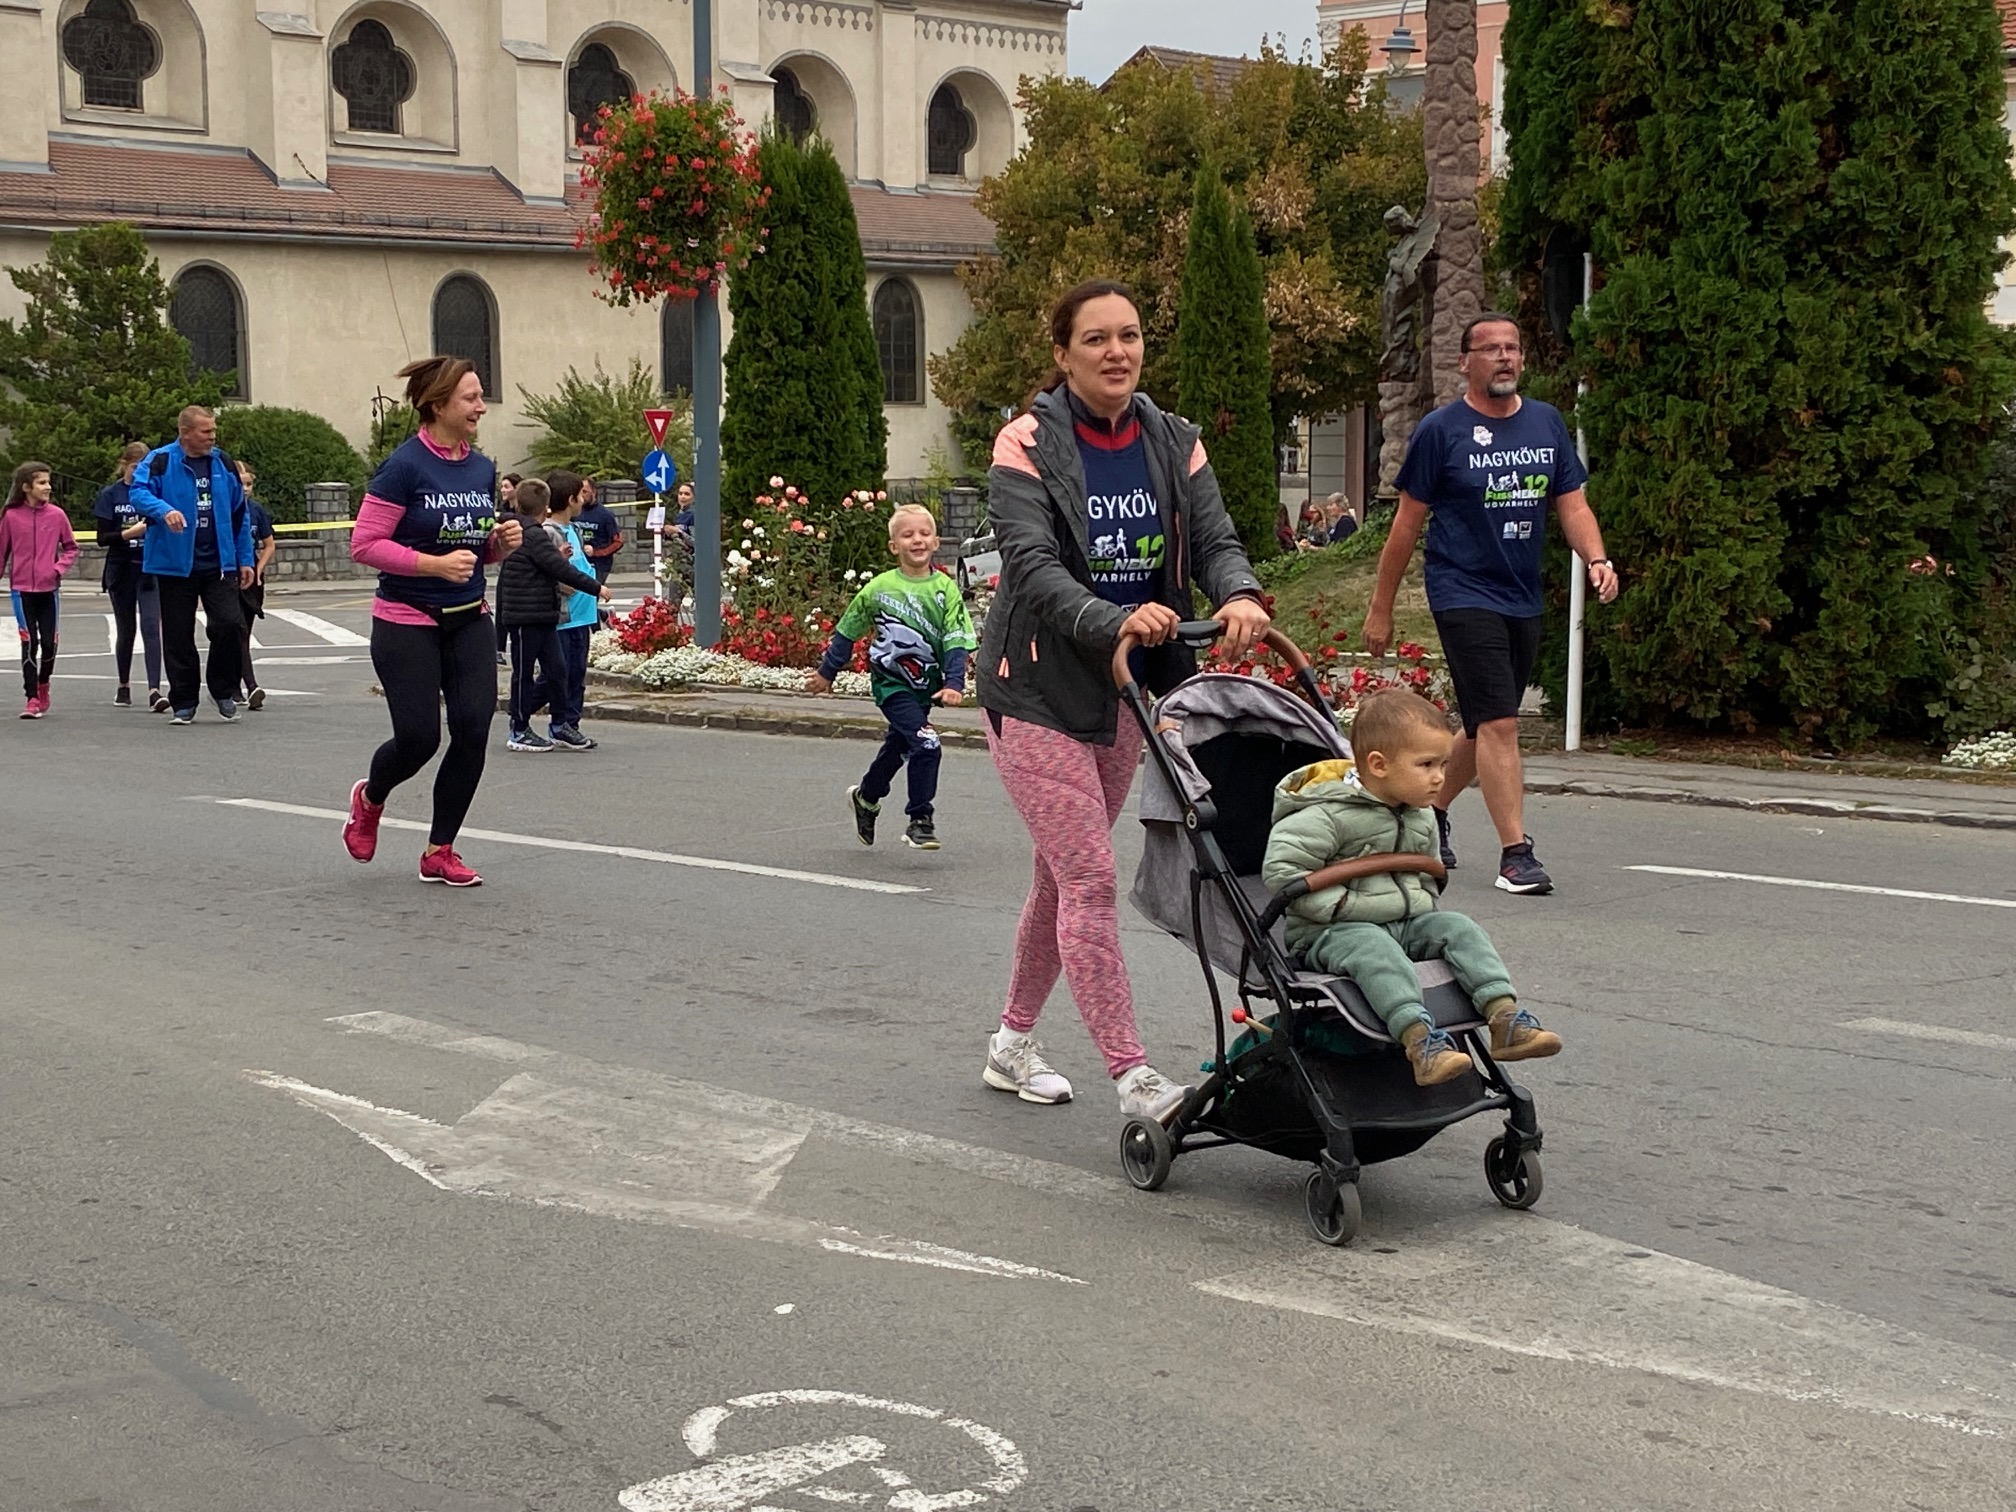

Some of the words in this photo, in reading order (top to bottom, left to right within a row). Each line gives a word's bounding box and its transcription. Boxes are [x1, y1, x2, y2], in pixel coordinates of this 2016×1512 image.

[1469, 446, 1555, 469] NAGYKÖVET
[1524, 474, 1549, 497] 12
[424, 490, 494, 509] NAGYKÖVE
[1087, 488, 1157, 520] GYKÖV
[1090, 571, 1151, 583] VARHELY
